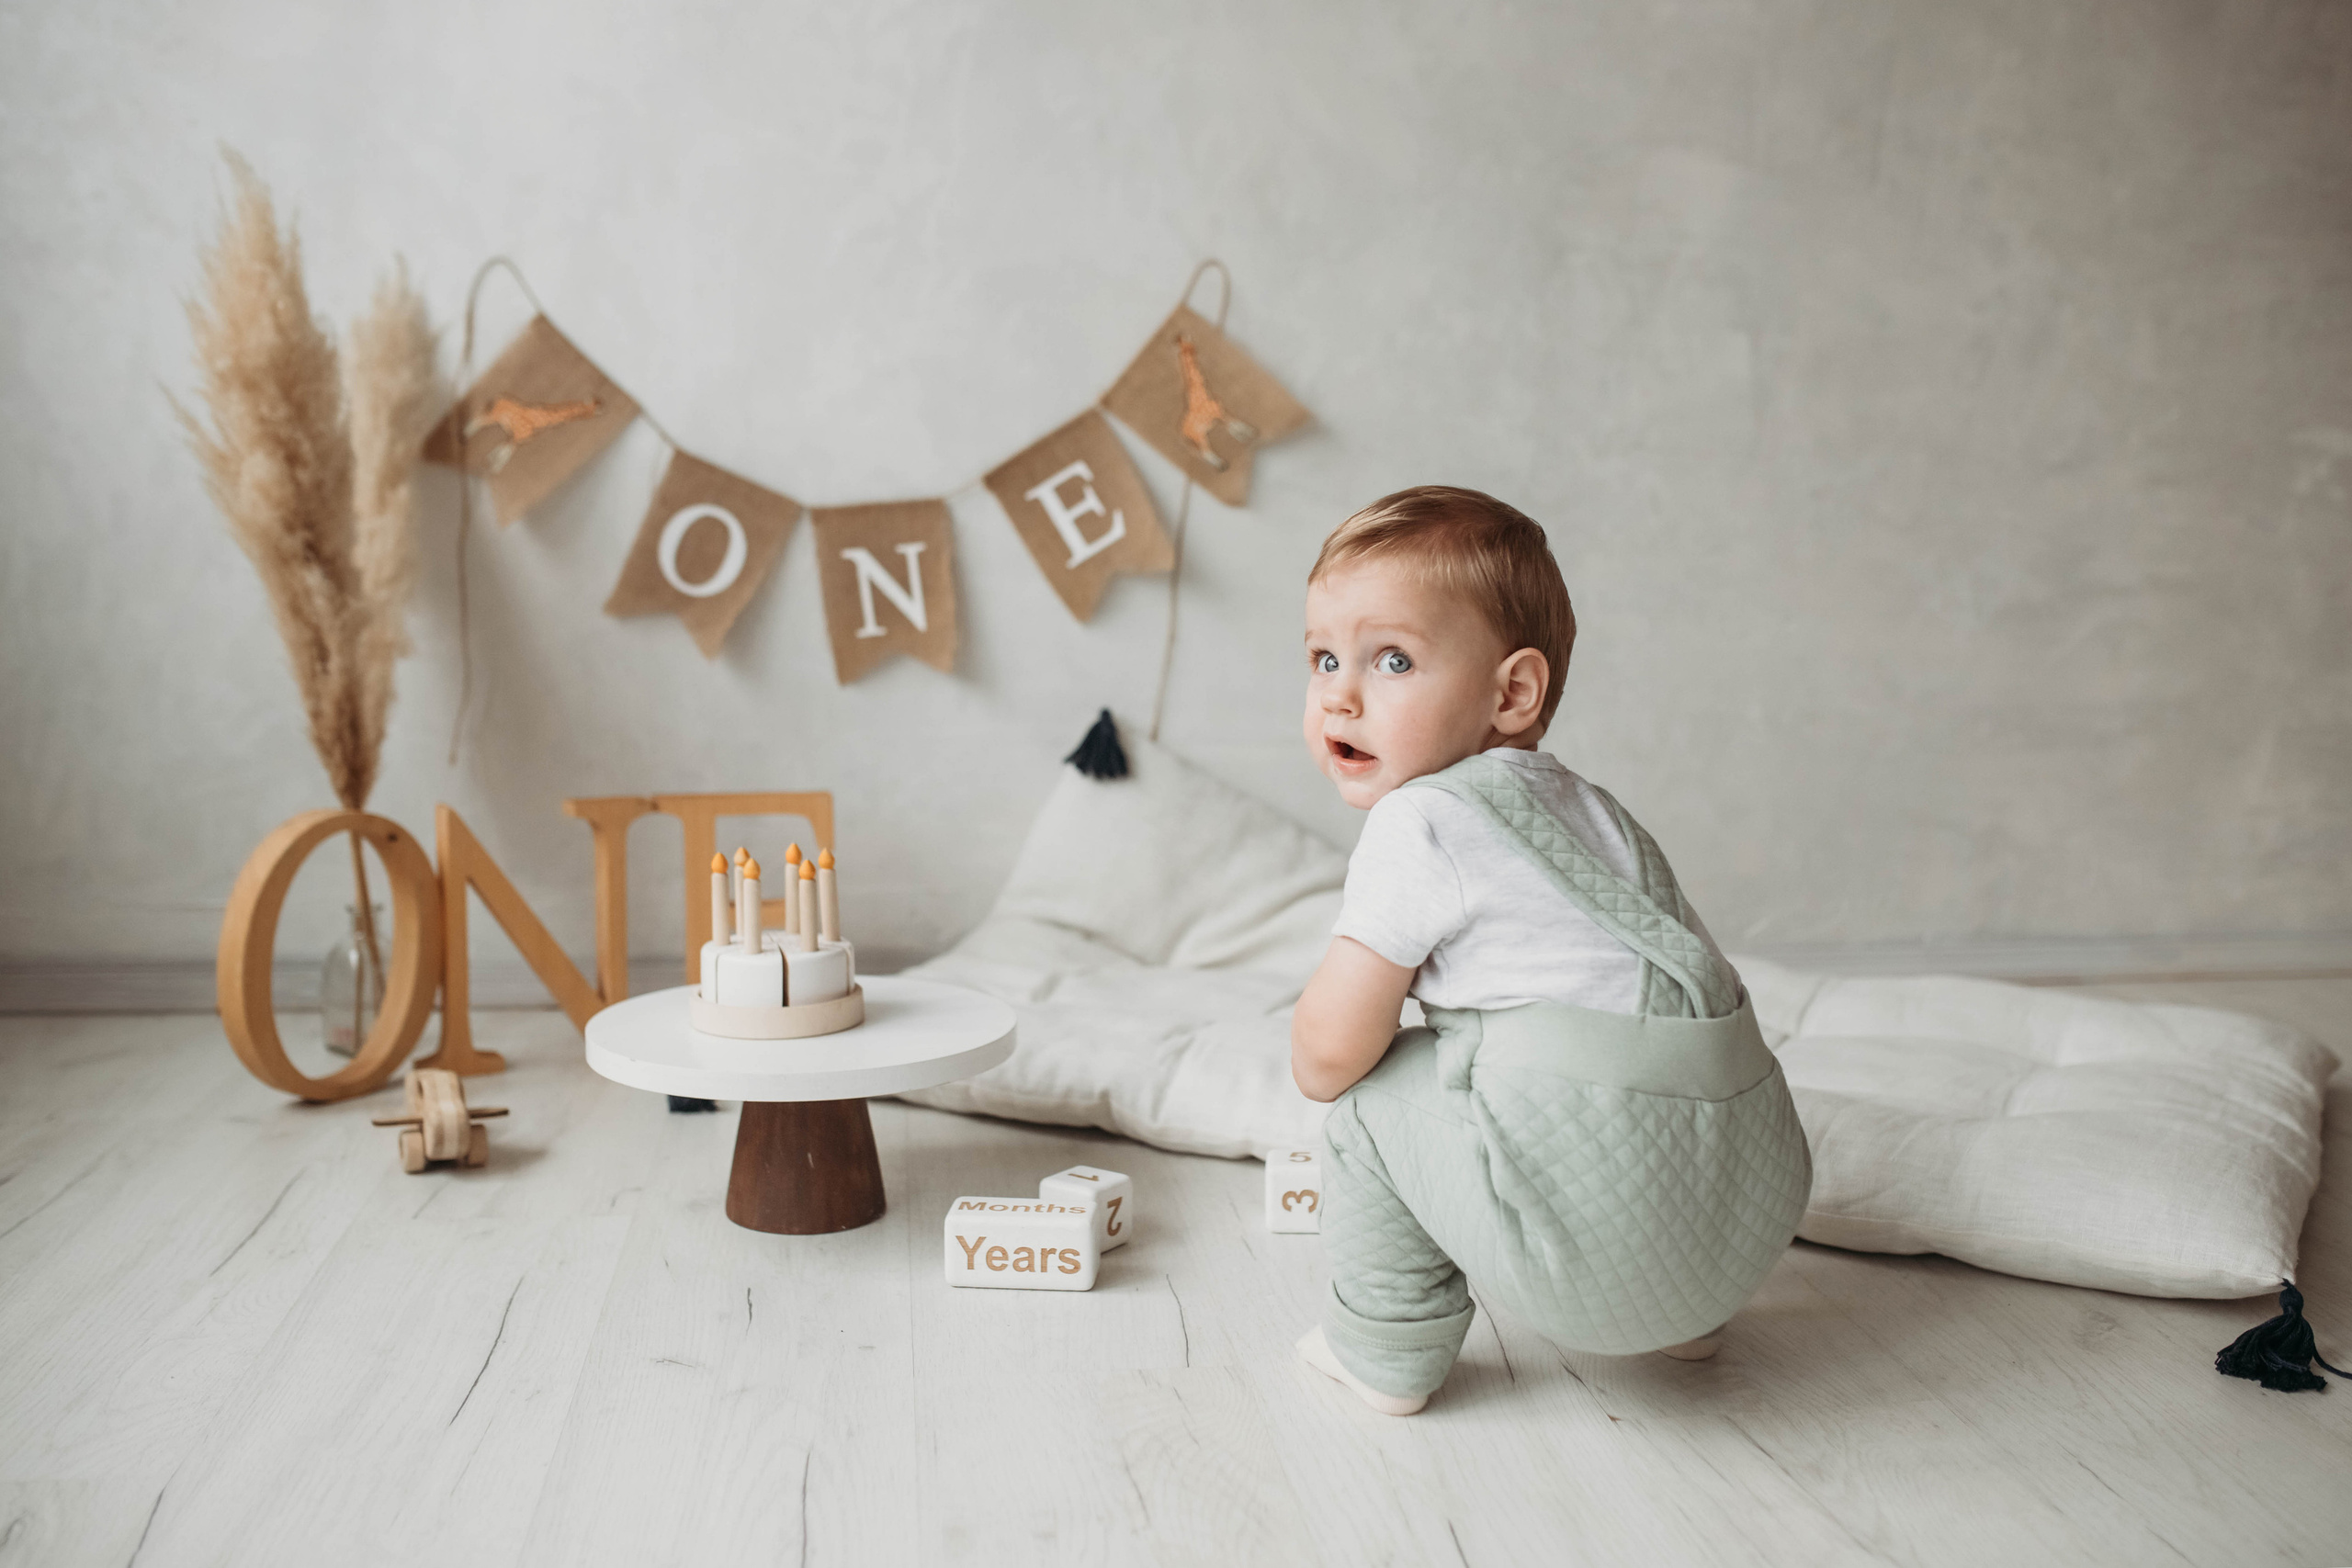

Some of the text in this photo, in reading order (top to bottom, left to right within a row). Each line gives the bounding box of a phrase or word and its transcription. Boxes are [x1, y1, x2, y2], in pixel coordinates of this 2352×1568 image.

[656, 459, 1127, 640] ONE
[1289, 1151, 1312, 1163] 5
[1067, 1173, 1100, 1182] 1
[957, 1201, 1087, 1214] Months
[1282, 1189, 1319, 1213] 3
[1106, 1196, 1123, 1236] 2
[955, 1235, 1081, 1275] Years
